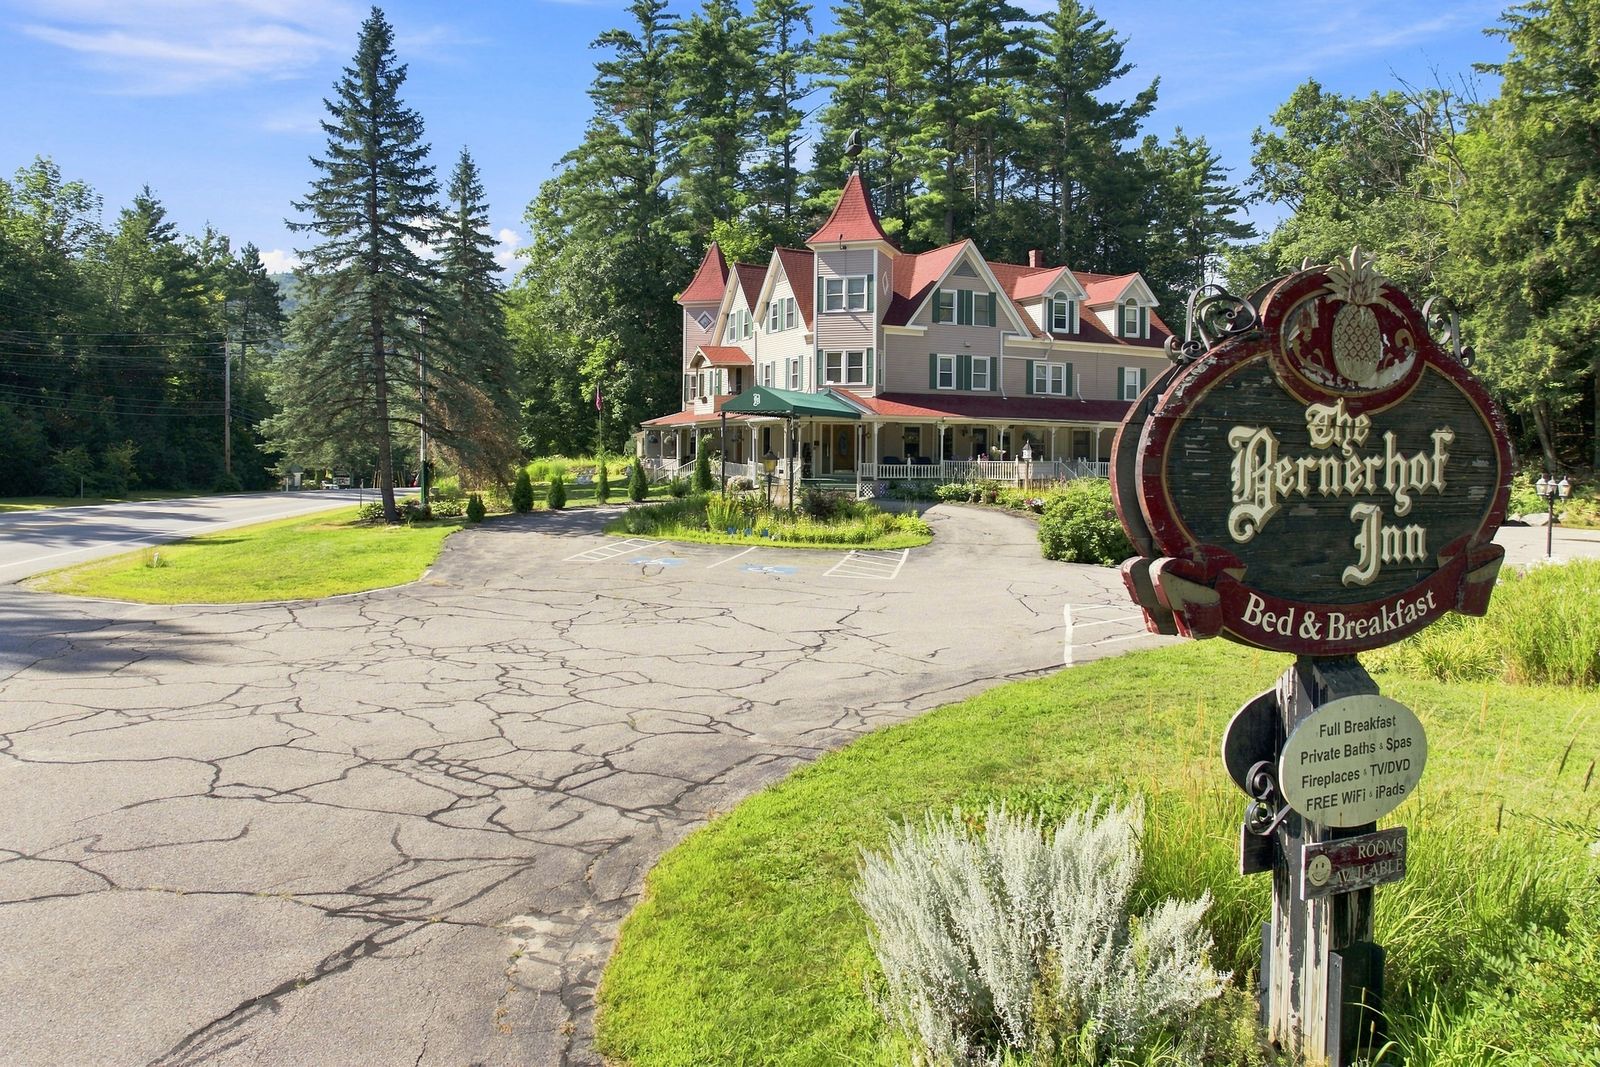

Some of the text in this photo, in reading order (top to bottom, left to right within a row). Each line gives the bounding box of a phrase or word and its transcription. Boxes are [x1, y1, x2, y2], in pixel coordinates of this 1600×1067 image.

[1304, 397, 1373, 457] The
[1227, 425, 1456, 544] Bernerhof
[1341, 502, 1428, 588] Inn
[1241, 590, 1437, 642] Bed & Breakfast
[1319, 715, 1397, 738] Full Breakfast
[1300, 746, 1341, 765] Private
[1344, 741, 1376, 758] Baths
[1386, 736, 1412, 753] Spas
[1301, 768, 1360, 789] Fireplaces
[1369, 758, 1411, 777] TV/DVD
[1306, 794, 1338, 812] FREE
[1342, 788, 1366, 805] WiFi
[1375, 781, 1406, 799] iPads
[1358, 836, 1404, 859] ROOMS
